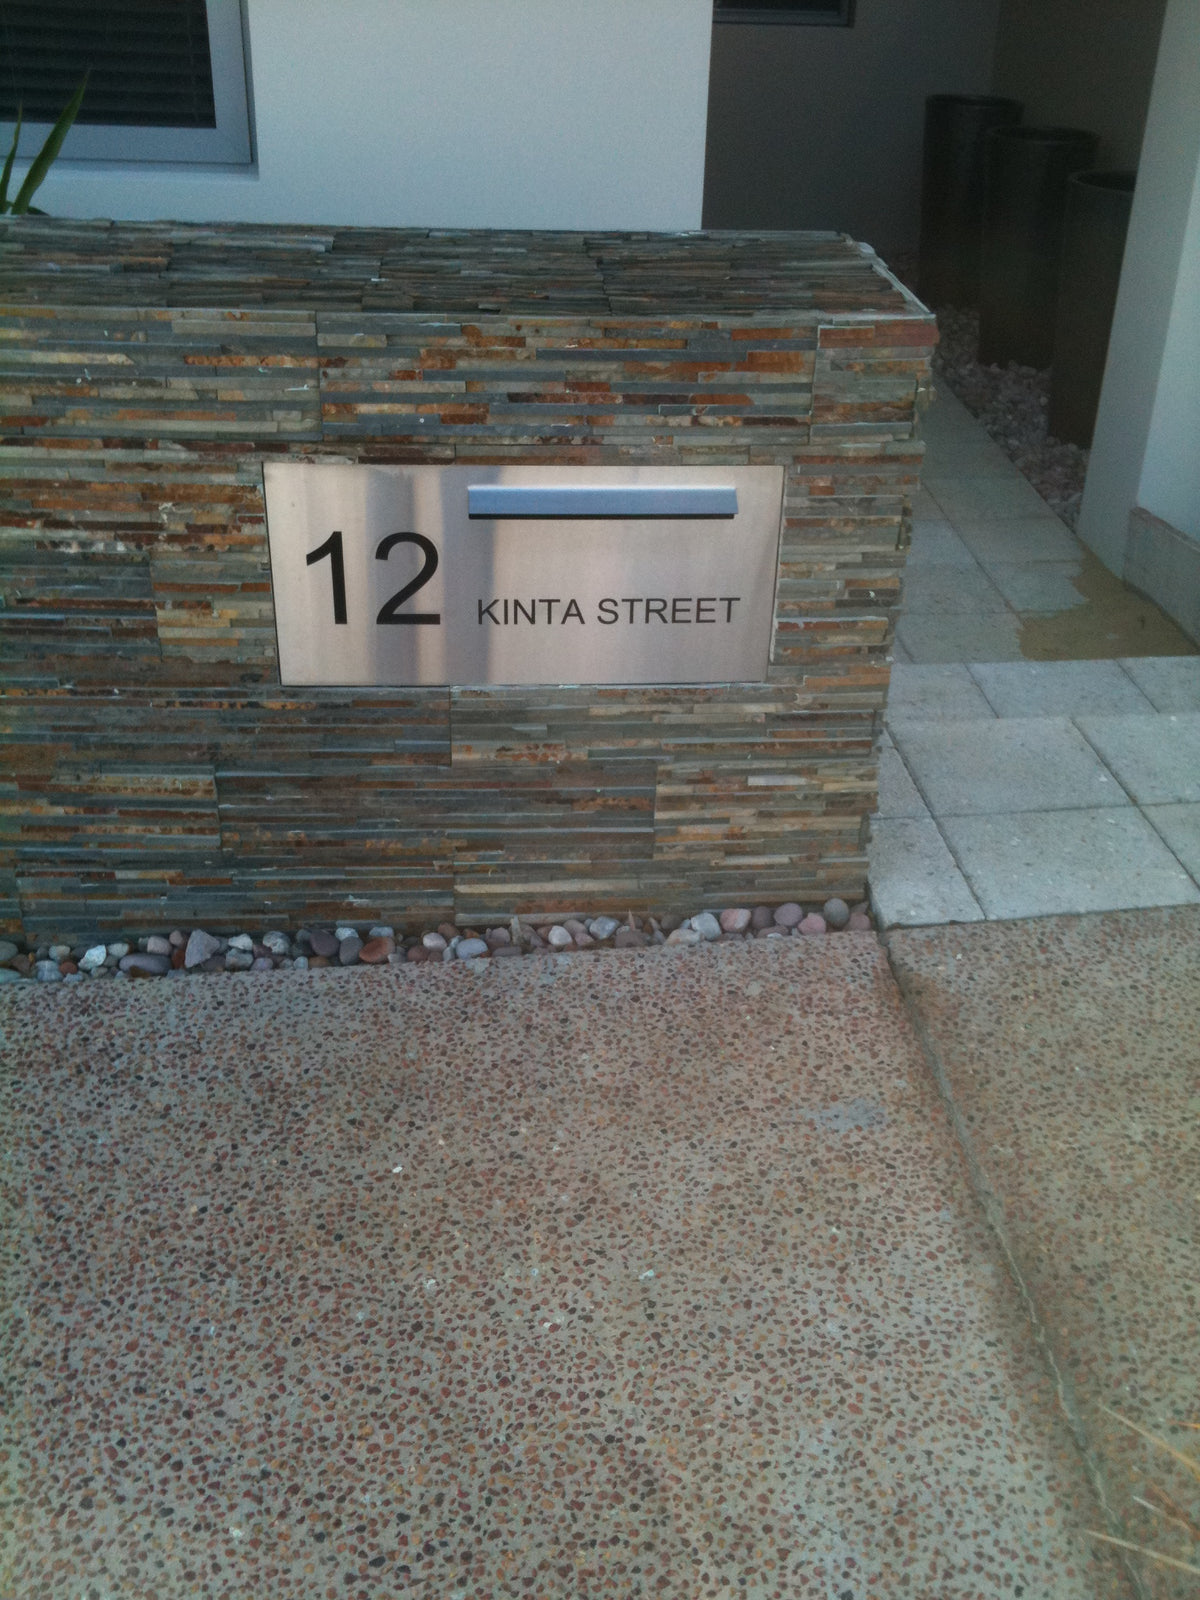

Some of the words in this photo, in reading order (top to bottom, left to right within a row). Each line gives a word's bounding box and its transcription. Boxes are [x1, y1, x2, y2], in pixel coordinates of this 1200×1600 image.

[305, 530, 441, 626] 12
[477, 598, 585, 626] KINTA
[597, 597, 741, 625] STREET
